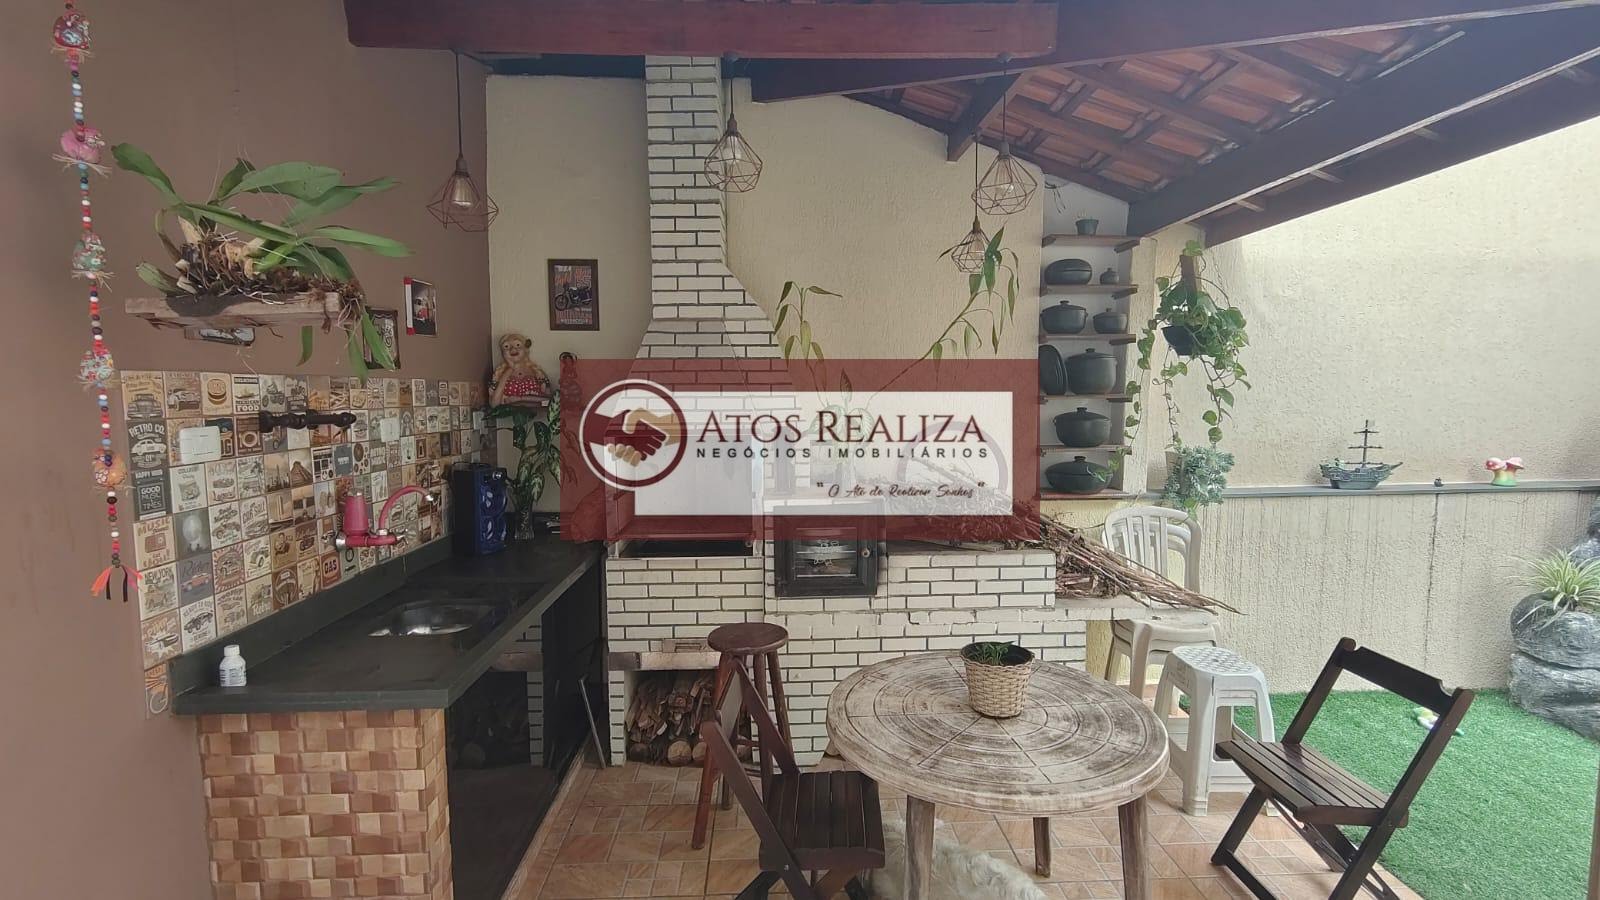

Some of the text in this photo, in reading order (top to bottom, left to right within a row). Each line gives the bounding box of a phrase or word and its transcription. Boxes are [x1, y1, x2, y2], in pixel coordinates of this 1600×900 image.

[128, 422, 153, 438] RETRO
[141, 485, 160, 494] GOOD
[324, 560, 337, 574] GAS
